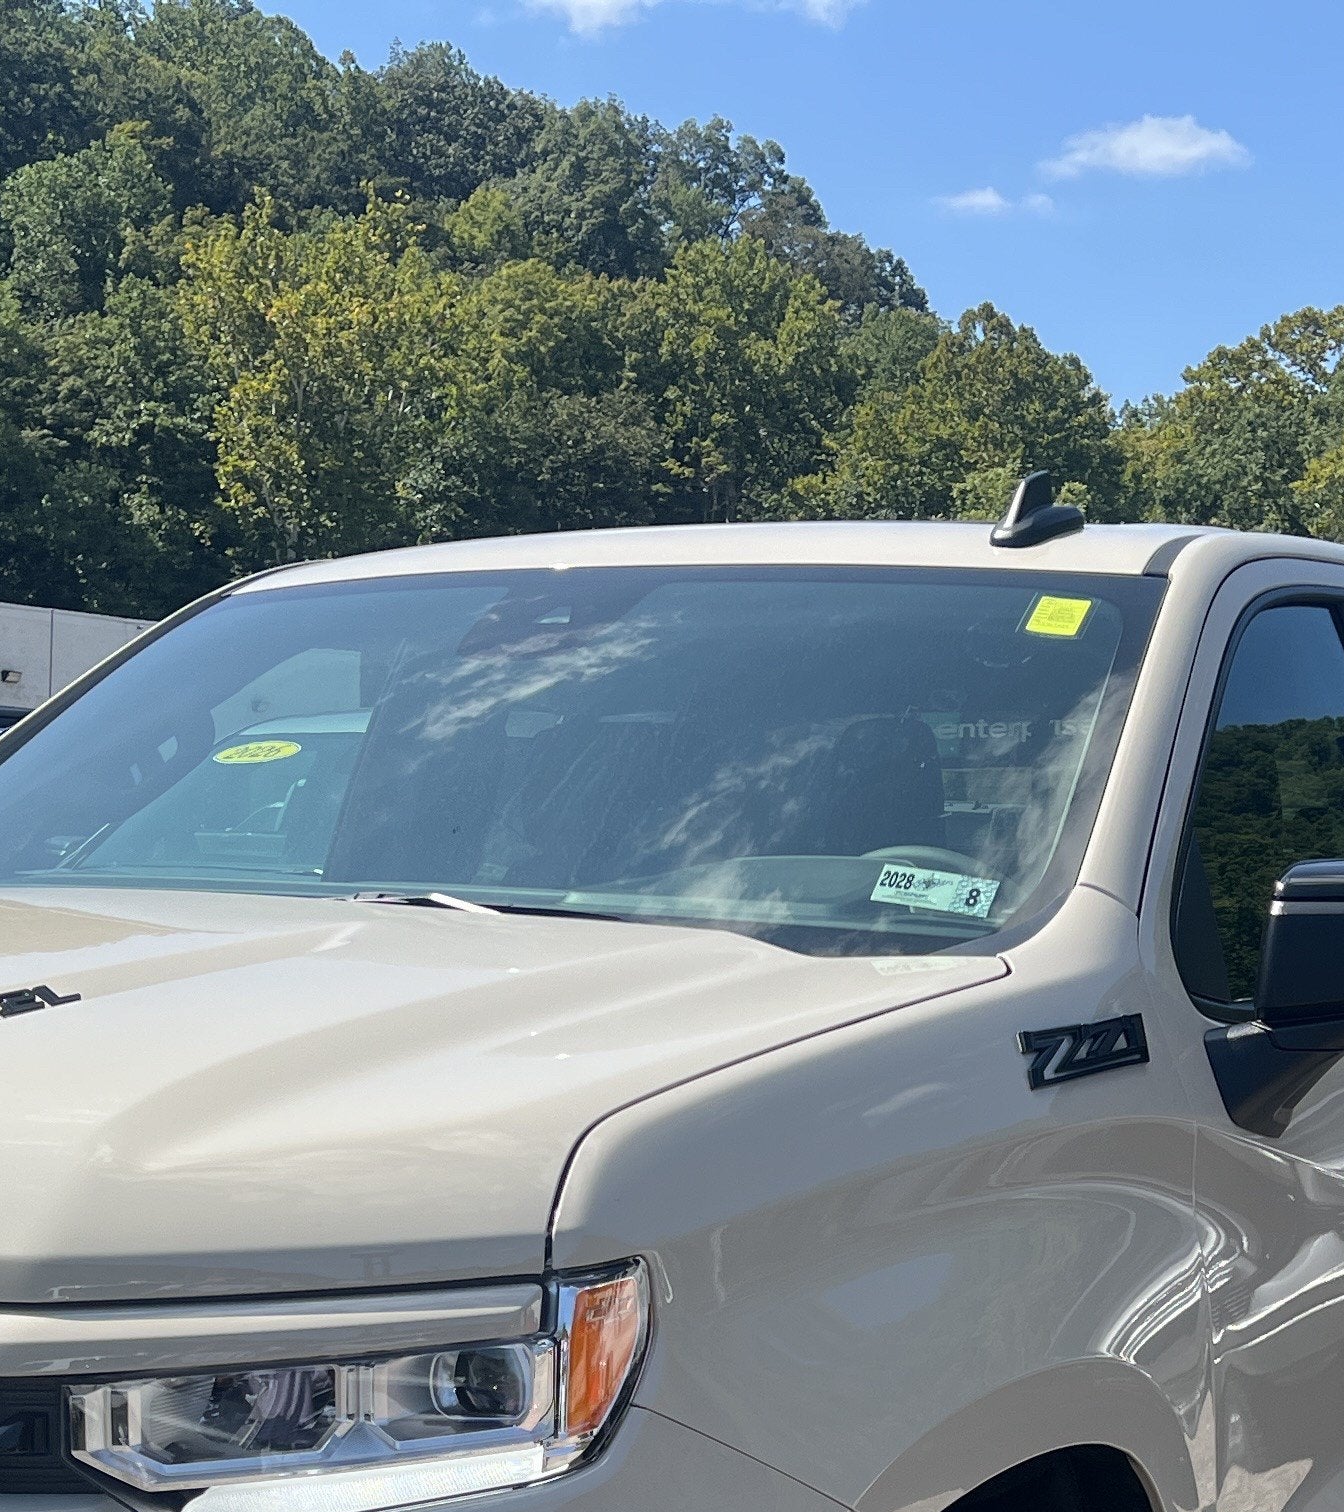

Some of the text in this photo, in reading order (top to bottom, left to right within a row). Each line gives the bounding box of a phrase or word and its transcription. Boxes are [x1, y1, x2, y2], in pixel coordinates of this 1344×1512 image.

[937, 718, 1088, 743] enterpis
[879, 870, 916, 890] 2028
[964, 888, 982, 906] 8
[1016, 1012, 1151, 1091] Z71
